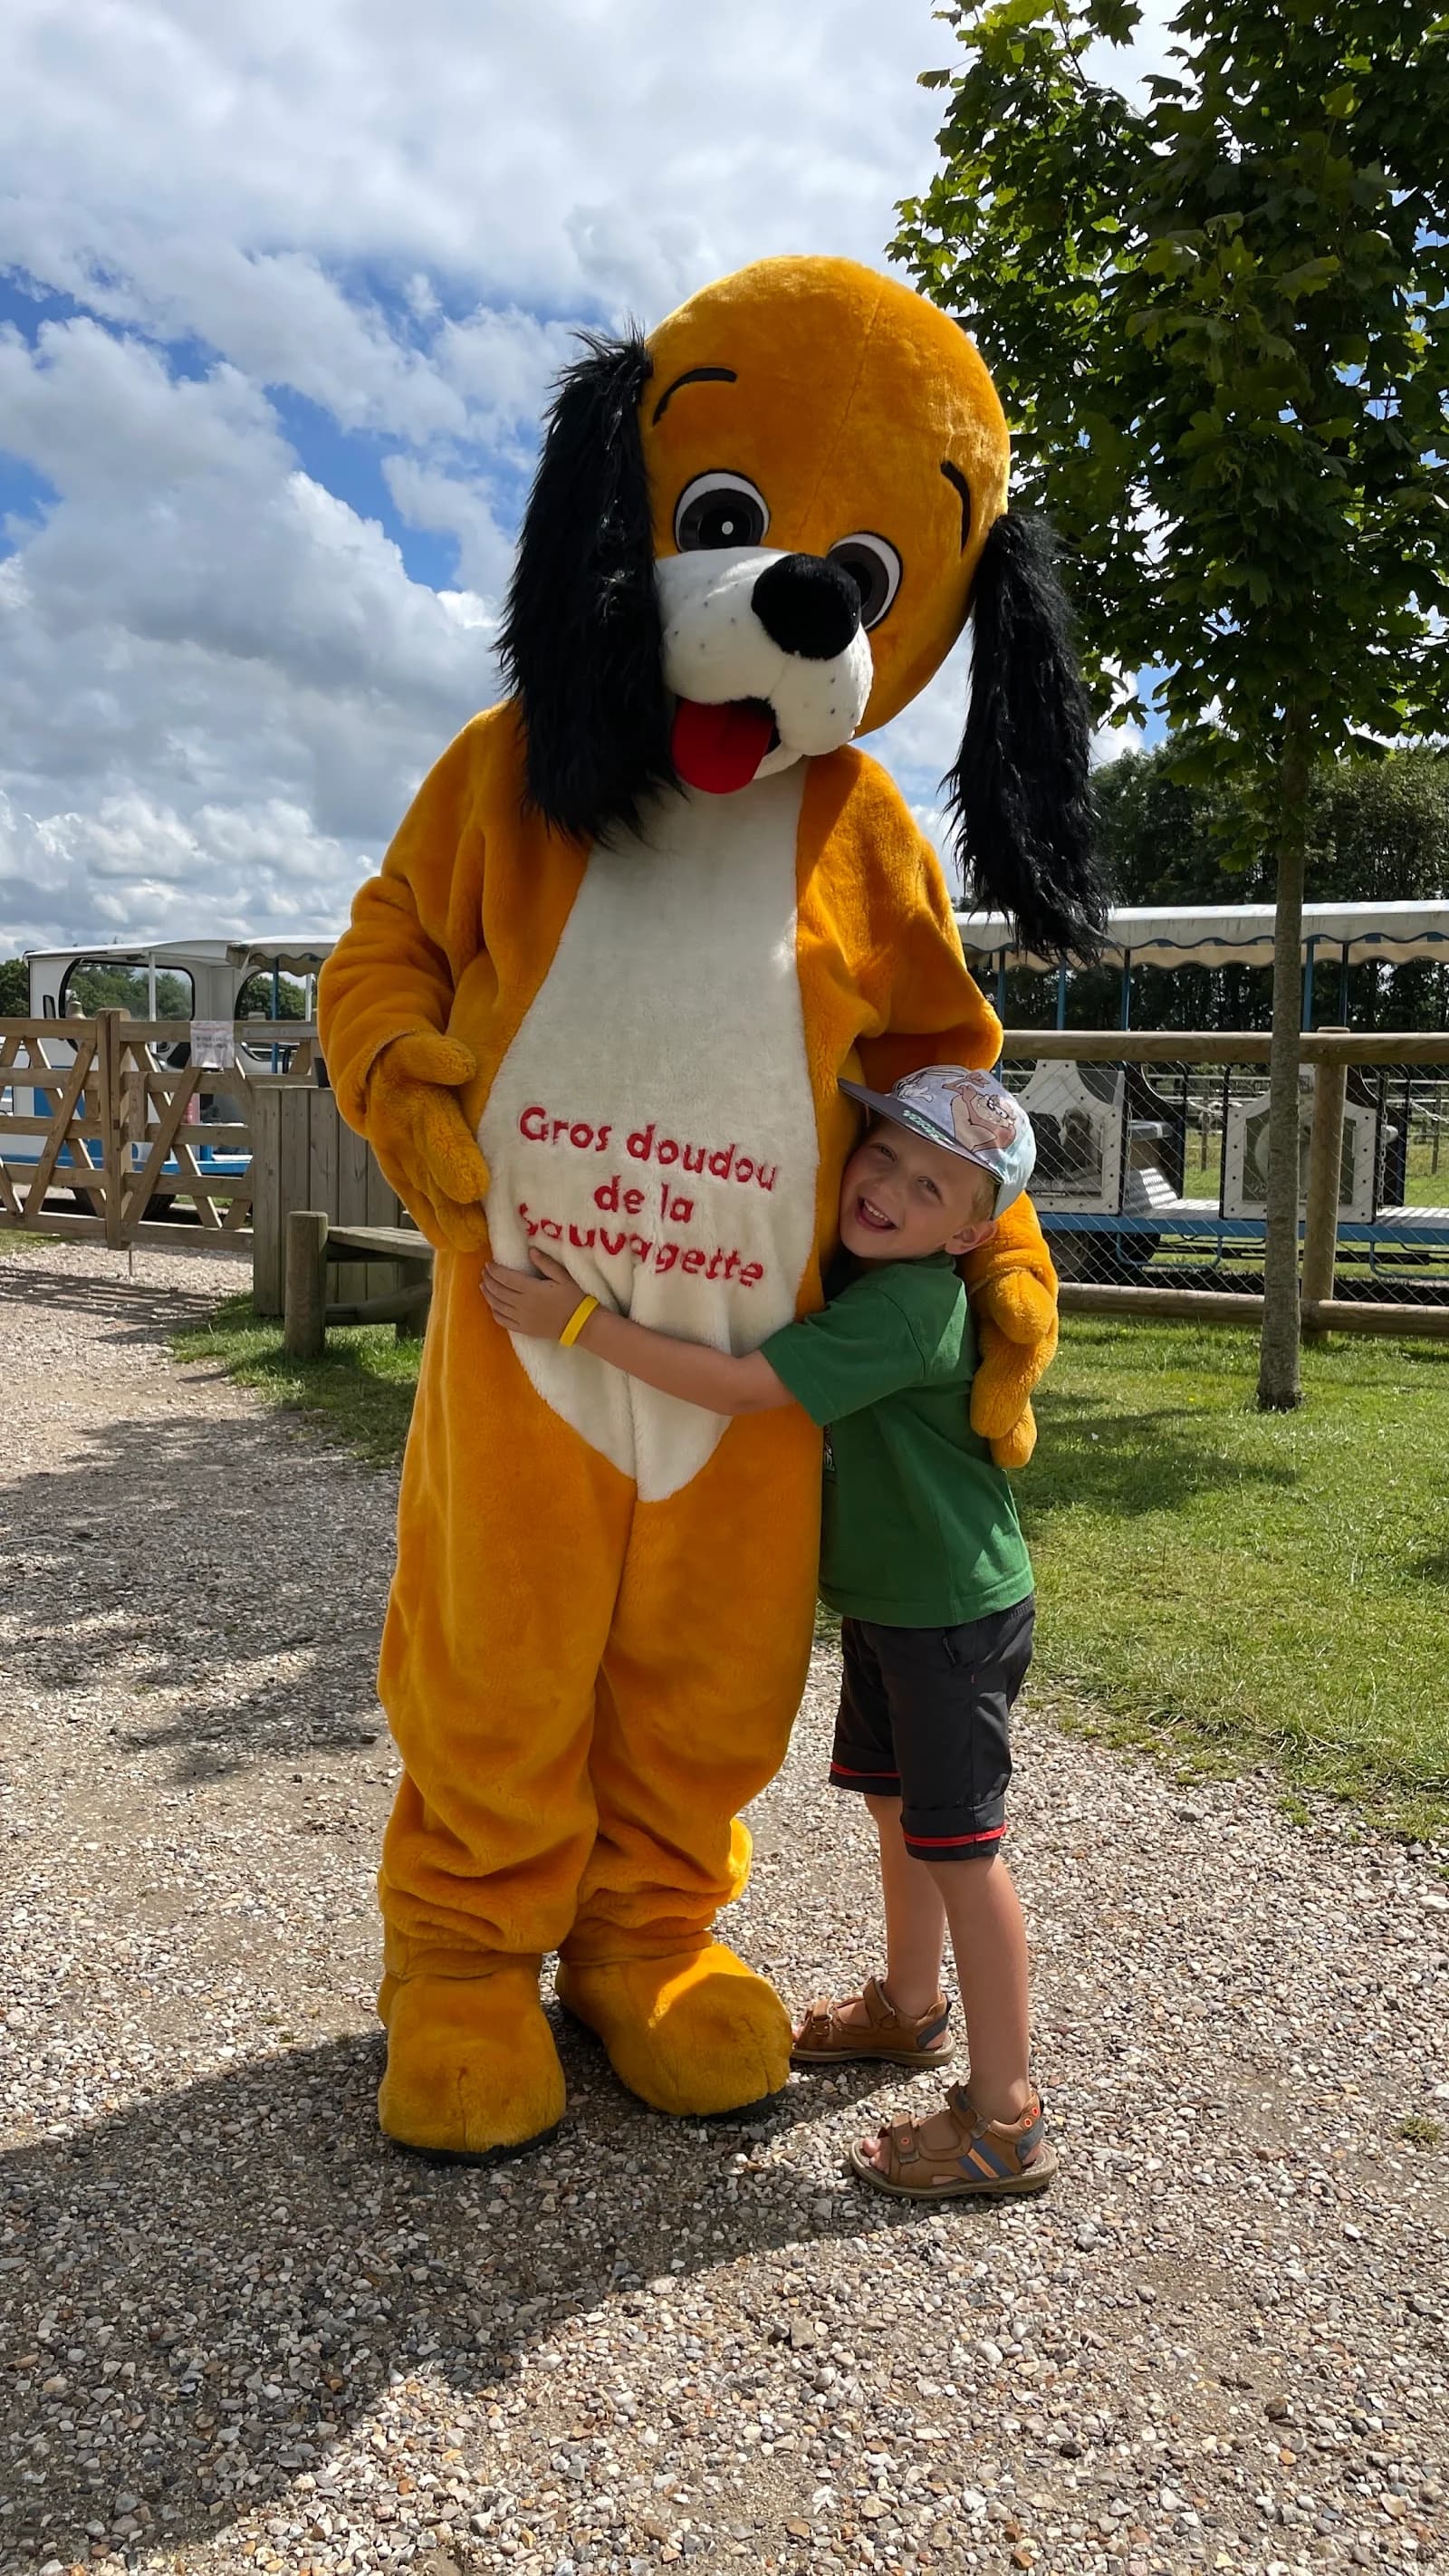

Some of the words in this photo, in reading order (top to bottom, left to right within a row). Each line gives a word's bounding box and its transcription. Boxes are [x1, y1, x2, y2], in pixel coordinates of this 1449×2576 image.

[519, 1106, 612, 1152] Gros
[626, 1123, 777, 1192] doudou
[593, 1175, 645, 1216] de
[660, 1182, 695, 1223] la
